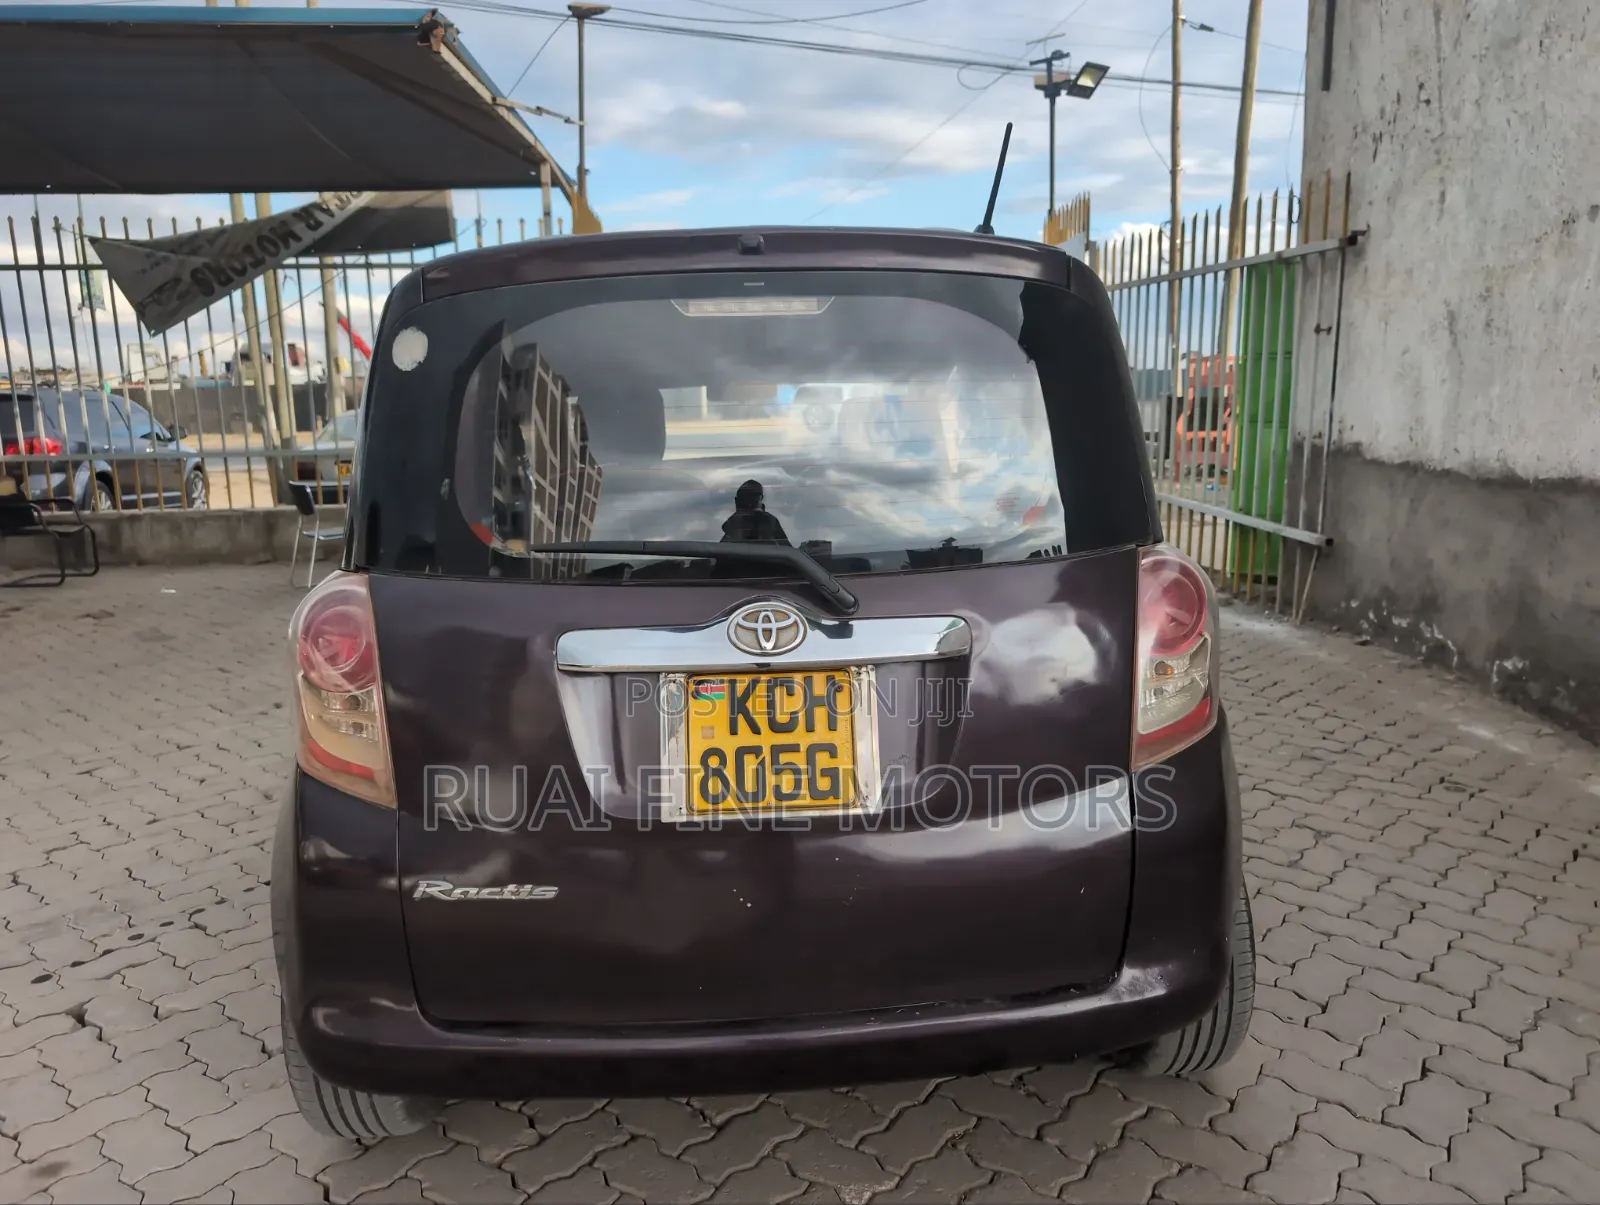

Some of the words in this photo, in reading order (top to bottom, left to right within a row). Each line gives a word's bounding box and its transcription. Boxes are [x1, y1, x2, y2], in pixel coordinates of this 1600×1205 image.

[190, 221, 302, 297] MOTORS
[728, 674, 838, 736] KCH
[699, 742, 842, 805] 805G
[412, 880, 559, 901] Ractis
